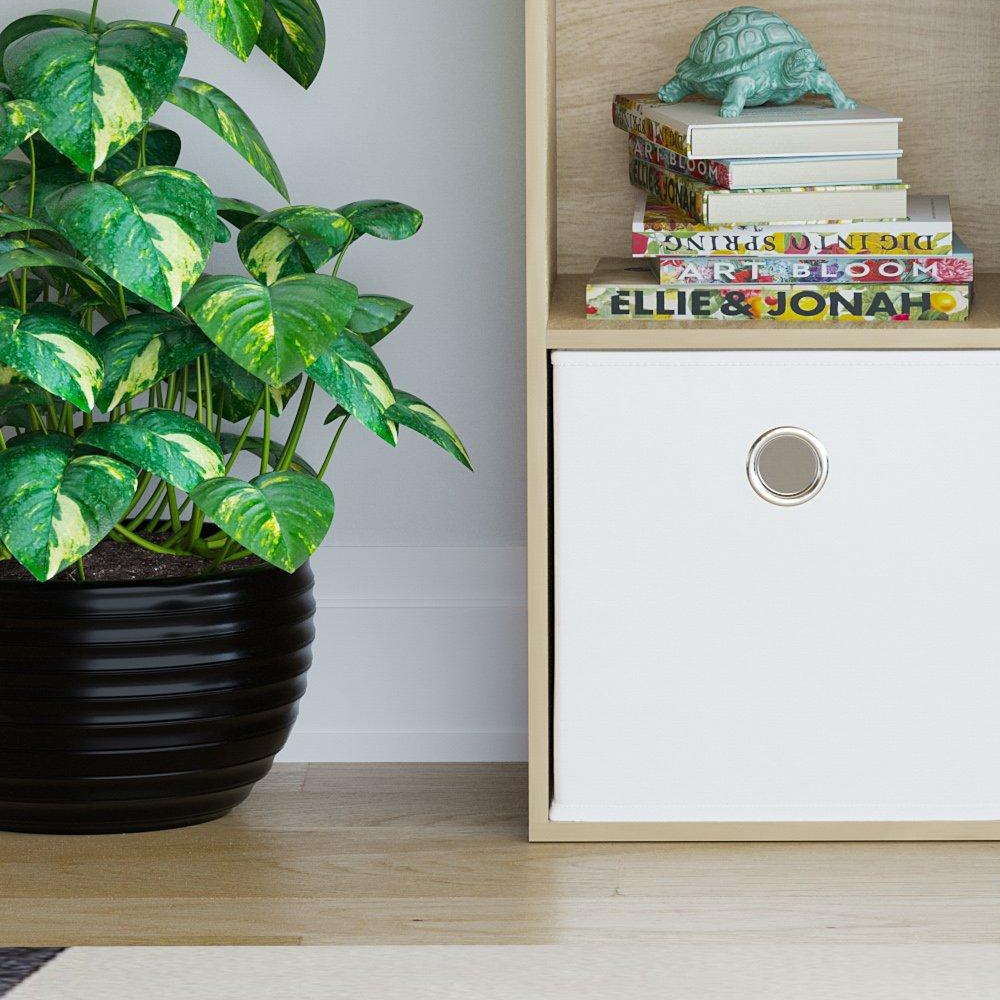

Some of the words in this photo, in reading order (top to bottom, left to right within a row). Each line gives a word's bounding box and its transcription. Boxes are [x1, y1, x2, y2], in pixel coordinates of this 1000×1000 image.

[634, 142, 662, 162] ART
[669, 152, 719, 180] BLOOM
[663, 234, 777, 251] SPRING
[790, 234, 863, 251] INTO
[880, 234, 934, 251] DIG
[677, 261, 766, 280] ART
[792, 262, 939, 280] BLOOM
[610, 290, 711, 316] ELLIE
[720, 291, 753, 316] &
[766, 291, 933, 317] JONAH
